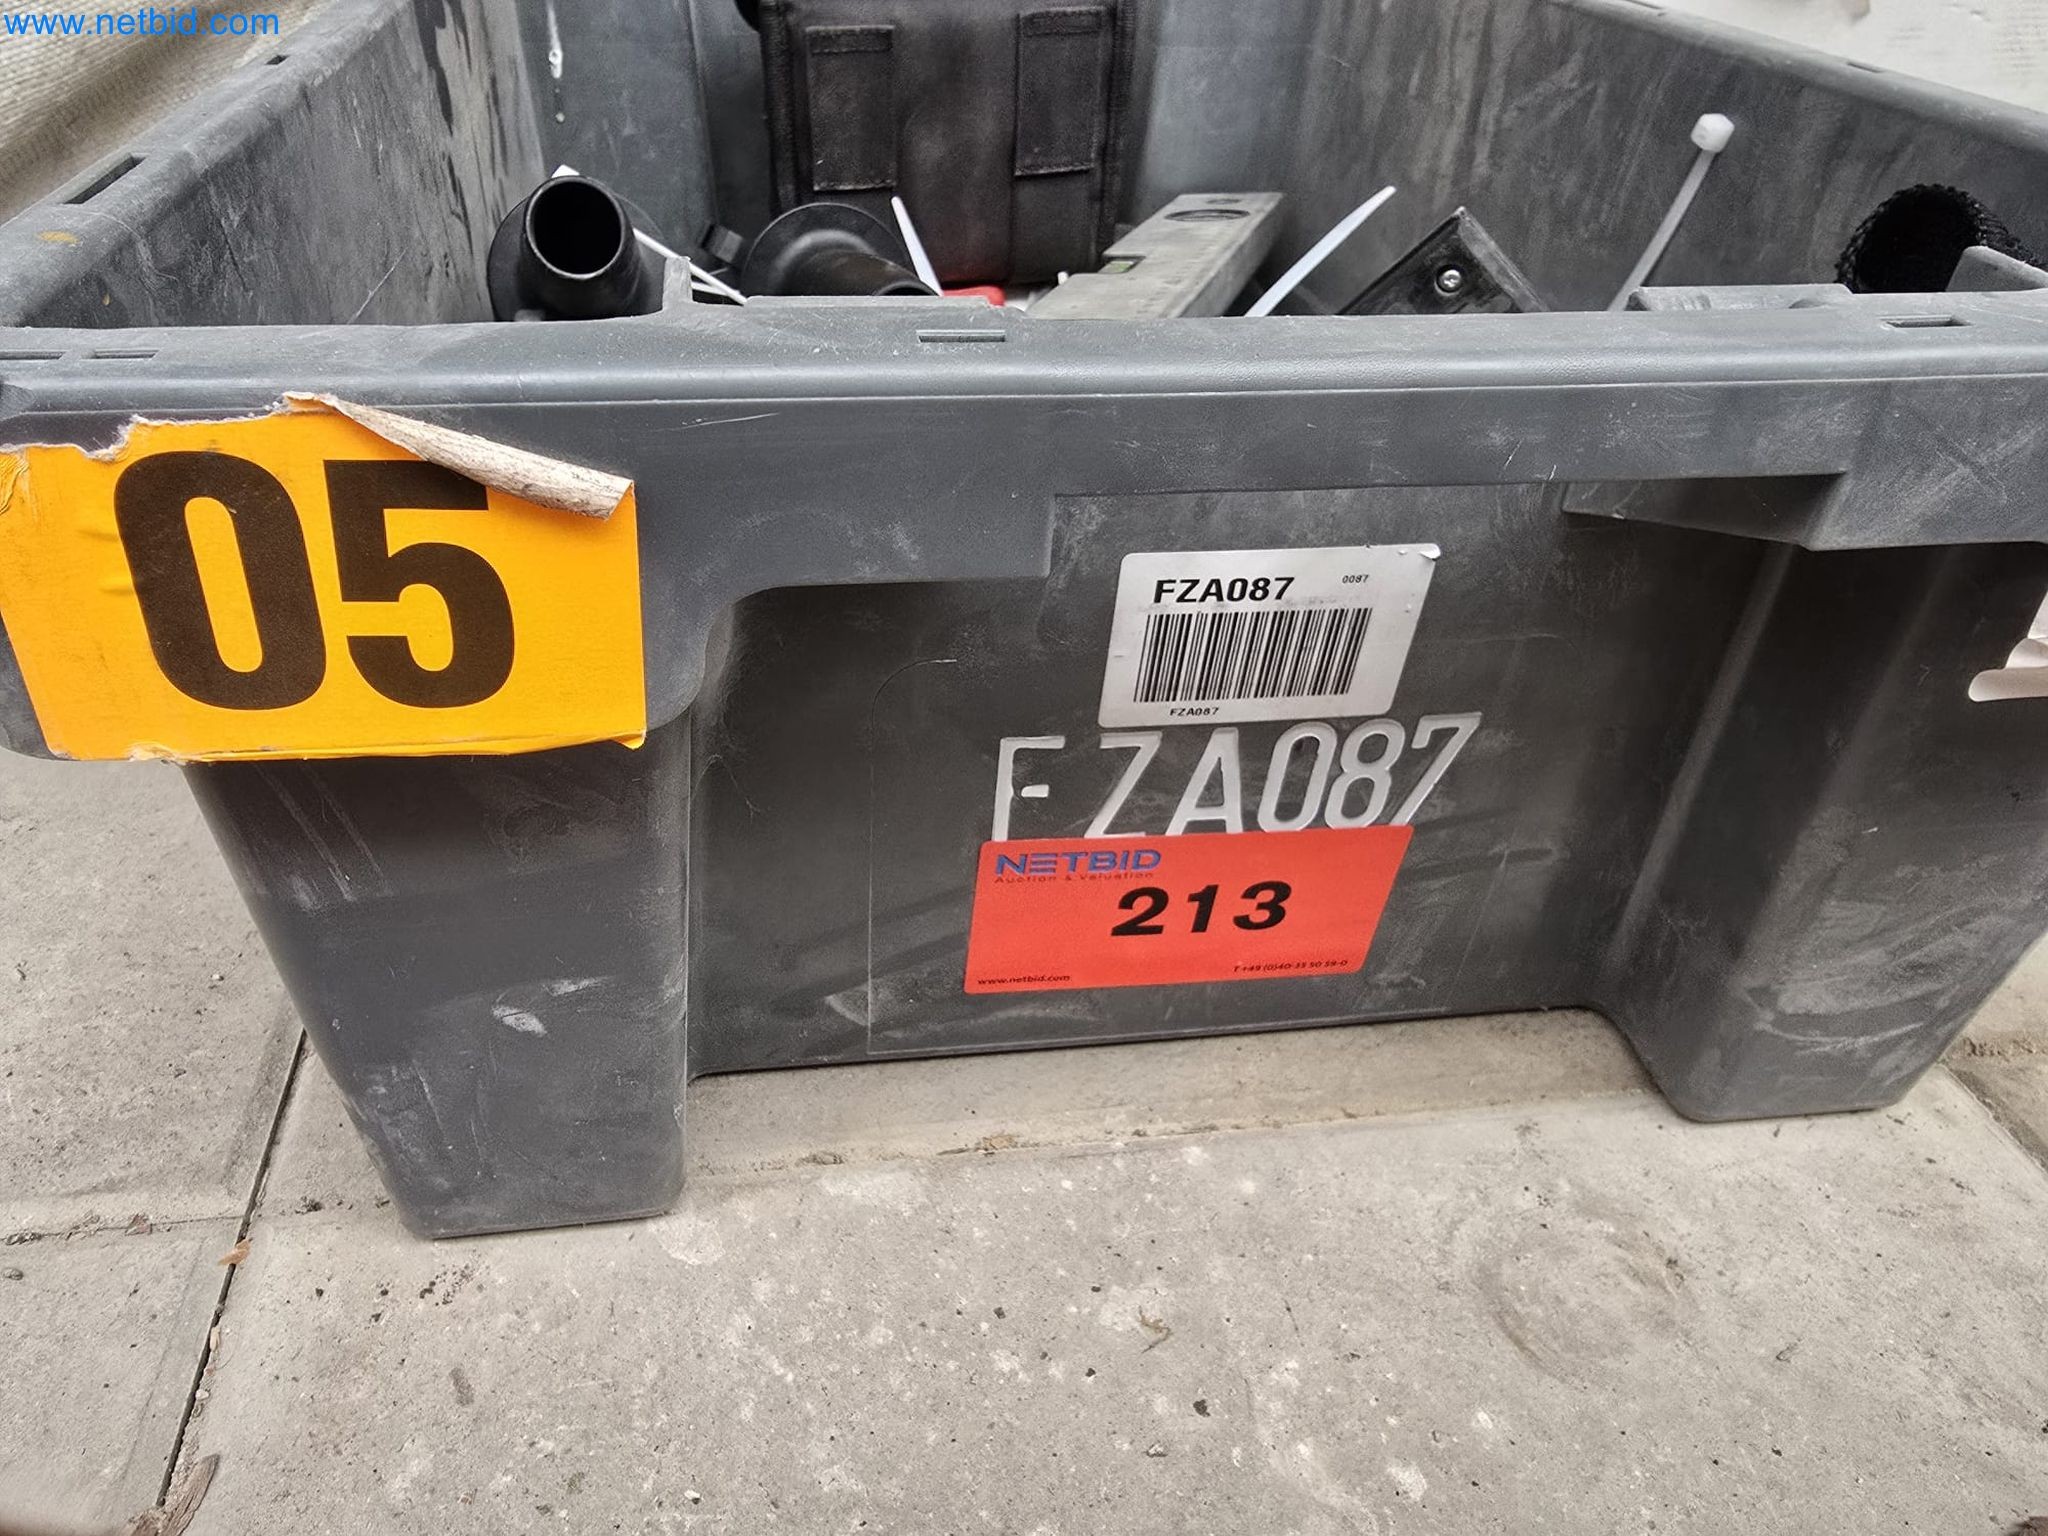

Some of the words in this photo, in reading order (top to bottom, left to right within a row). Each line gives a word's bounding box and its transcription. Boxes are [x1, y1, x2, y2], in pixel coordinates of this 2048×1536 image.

[113, 451, 516, 711] 05
[1153, 576, 1295, 603] FZA087
[1342, 574, 1370, 585] 0087
[1170, 706, 1220, 718] FZA087
[992, 711, 1483, 841] FZA087
[996, 849, 1162, 875] NETBID
[994, 875, 1056, 884] Auction
[1080, 872, 1154, 881] Valuation
[1111, 881, 1293, 937] 213
[977, 974, 1071, 985] www.netbid.com
